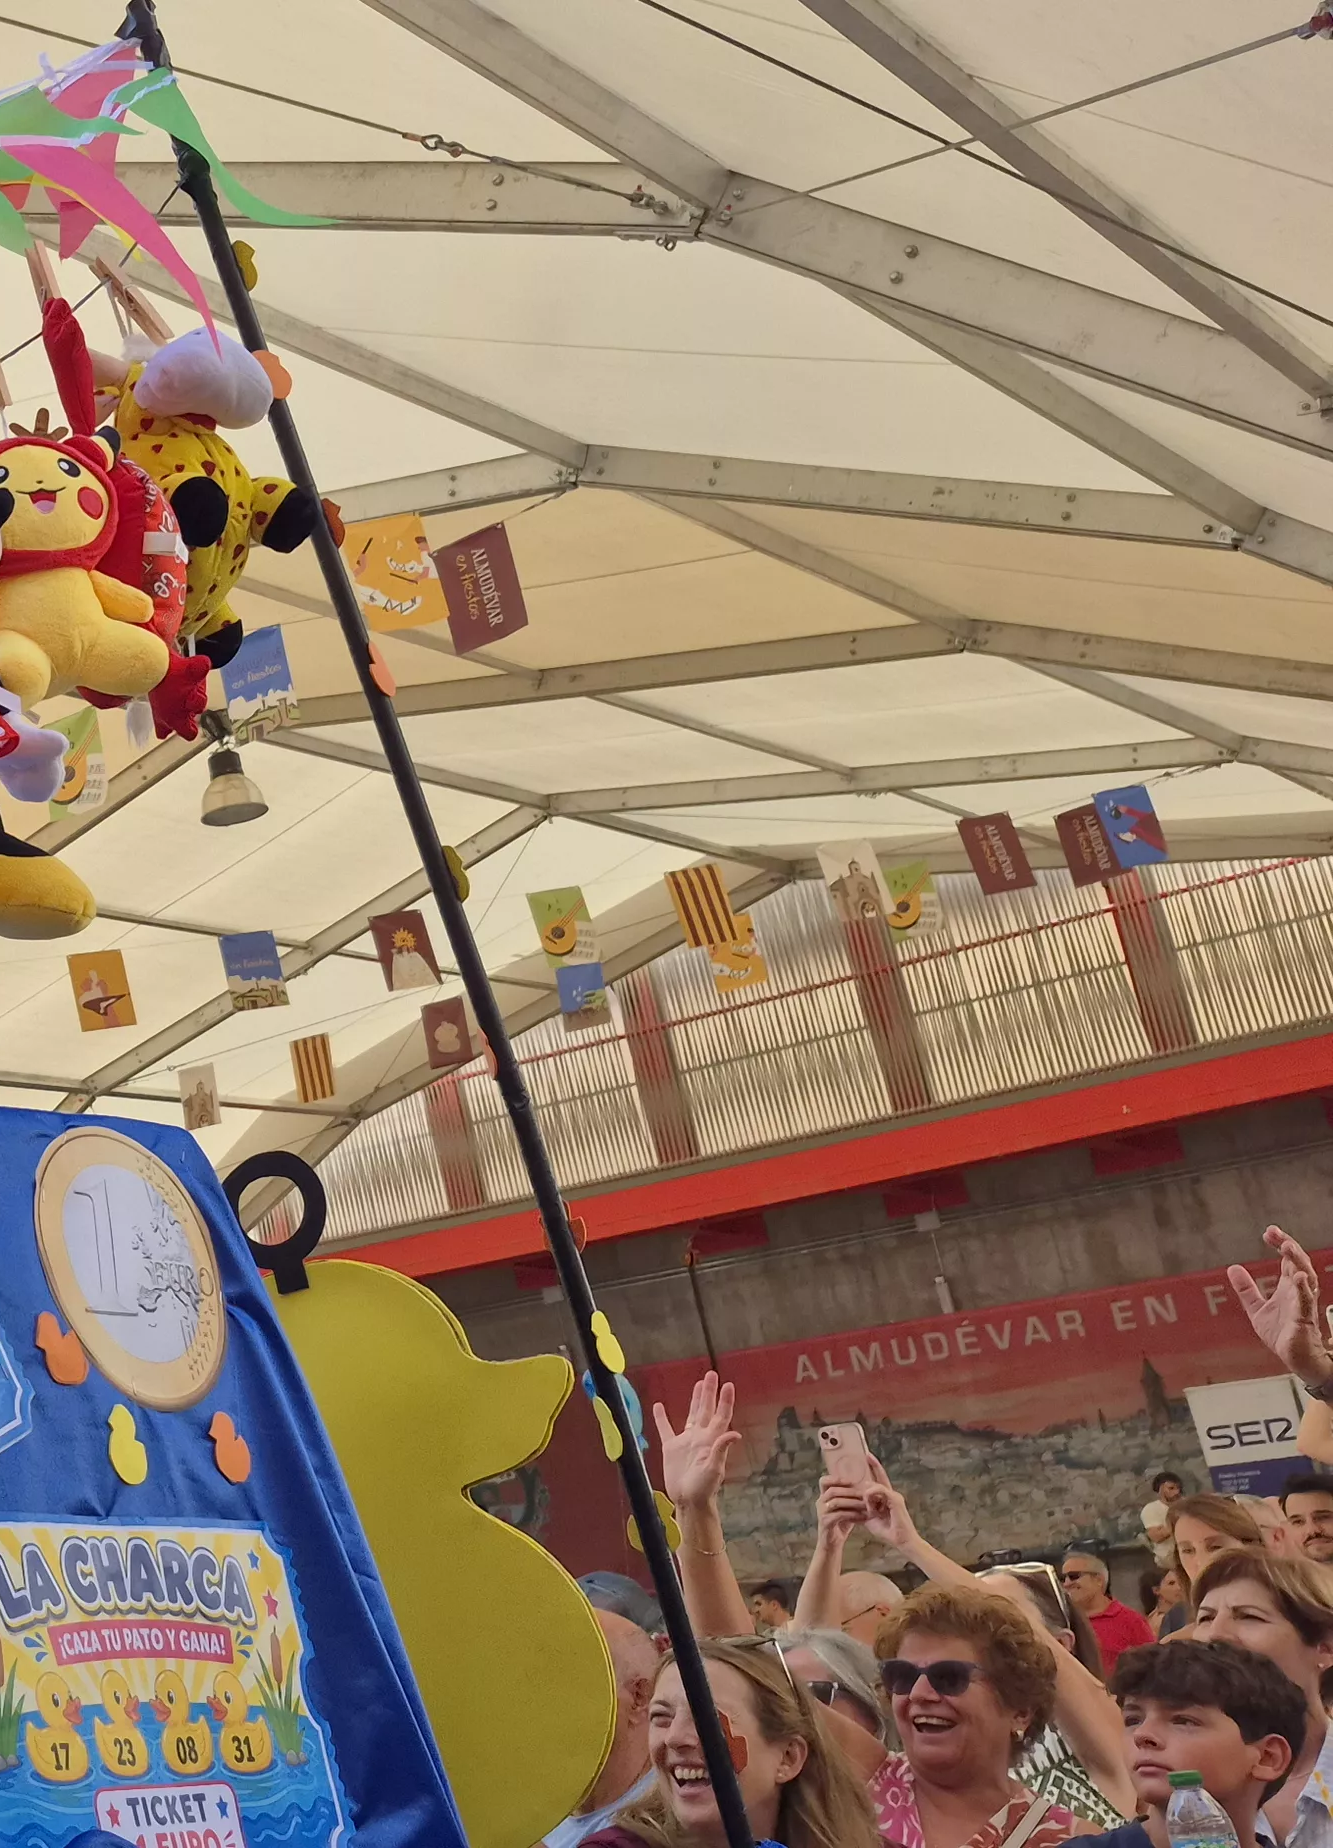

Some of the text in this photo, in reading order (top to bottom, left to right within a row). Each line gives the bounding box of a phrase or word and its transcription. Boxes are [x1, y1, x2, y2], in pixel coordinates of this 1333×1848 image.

[455, 554, 481, 621] en fiestas
[470, 547, 504, 628] ALMUDÉVAR
[794, 1291, 1179, 1384] ALMUDÉVAR EN
[1206, 1417, 1298, 1451] SER
[59, 1535, 258, 1631] CHARCA
[58, 1627, 226, 1661] ¡CAZA TU PATO Y GANA!
[50, 1735, 256, 1771] 17 23 08 31
[126, 1792, 207, 1828] TICKET
